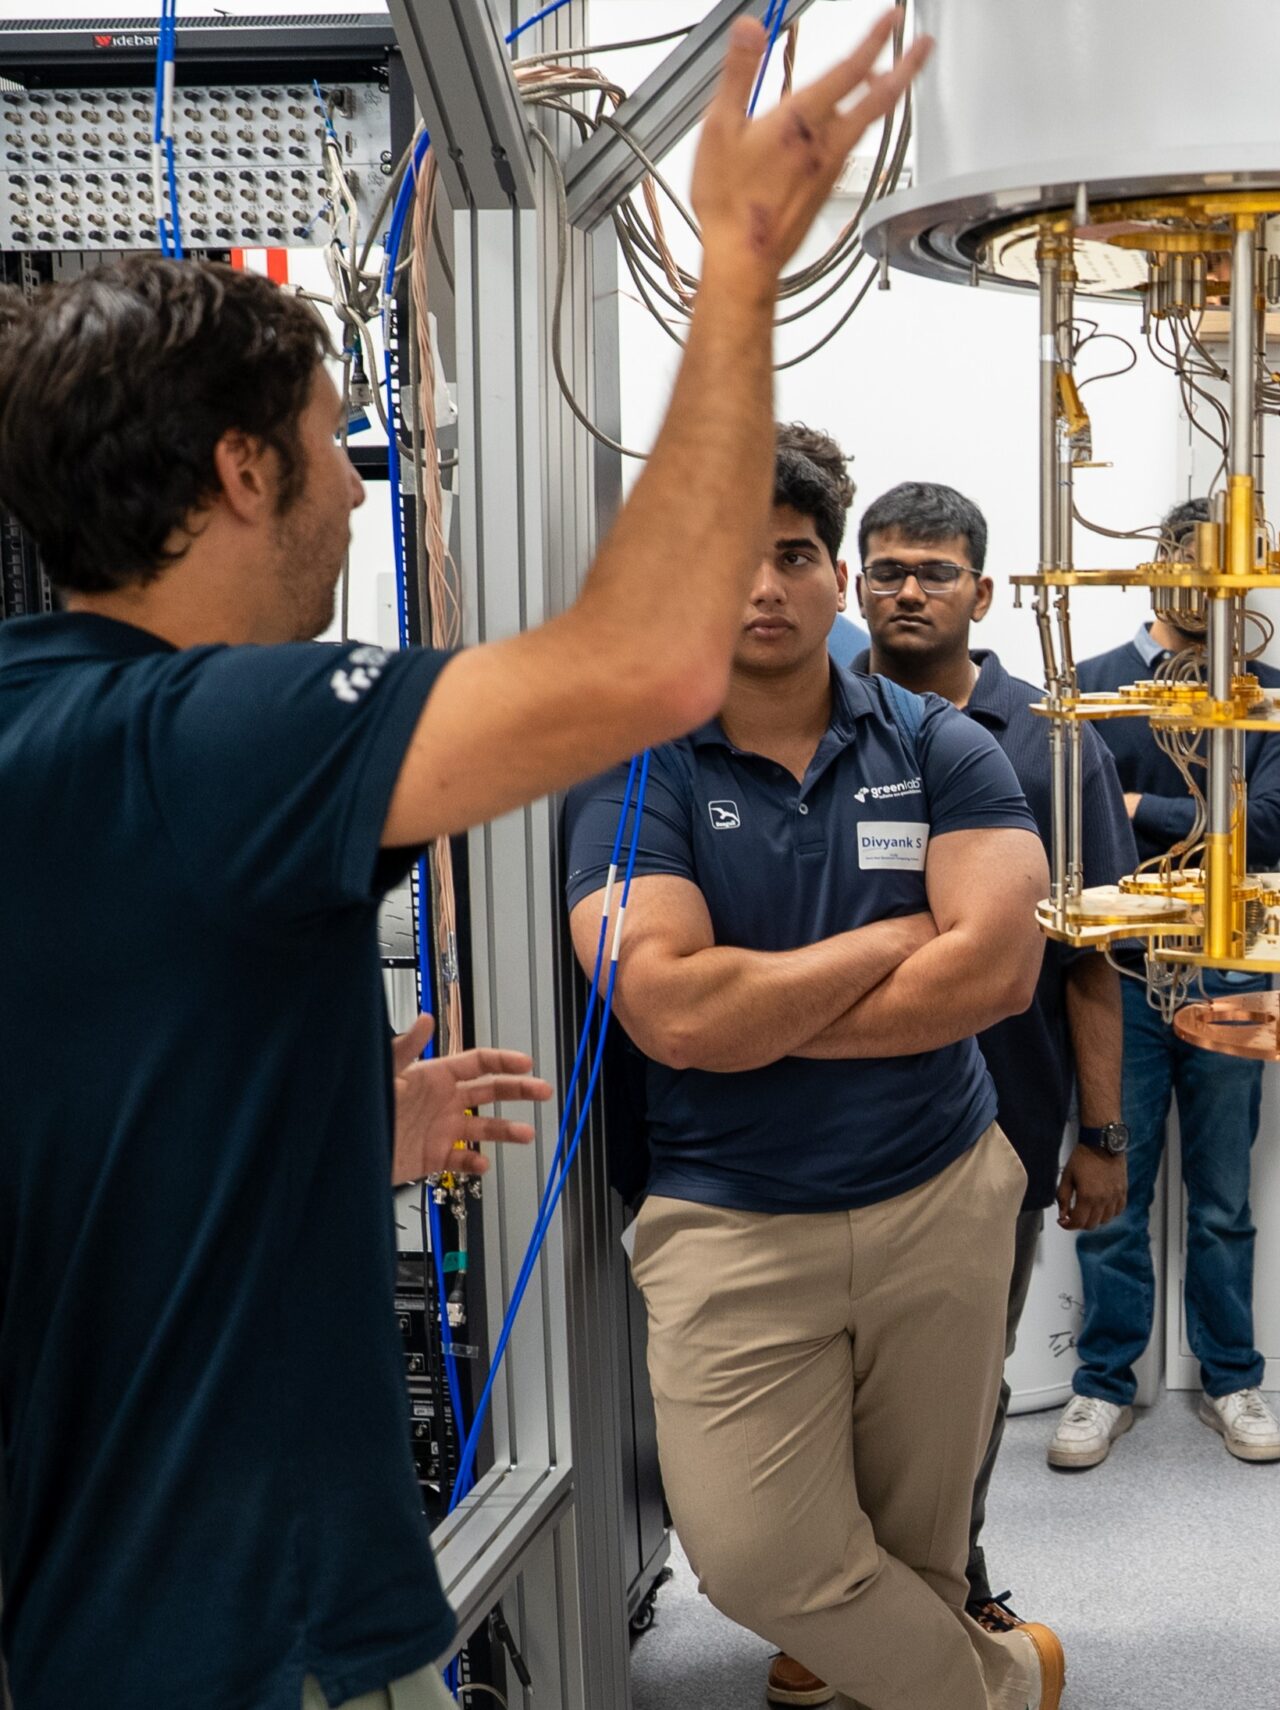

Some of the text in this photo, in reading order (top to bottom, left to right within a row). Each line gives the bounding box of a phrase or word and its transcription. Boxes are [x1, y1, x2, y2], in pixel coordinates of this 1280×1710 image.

[870, 779, 921, 799] greenlab
[861, 836, 923, 851] Divyank S
